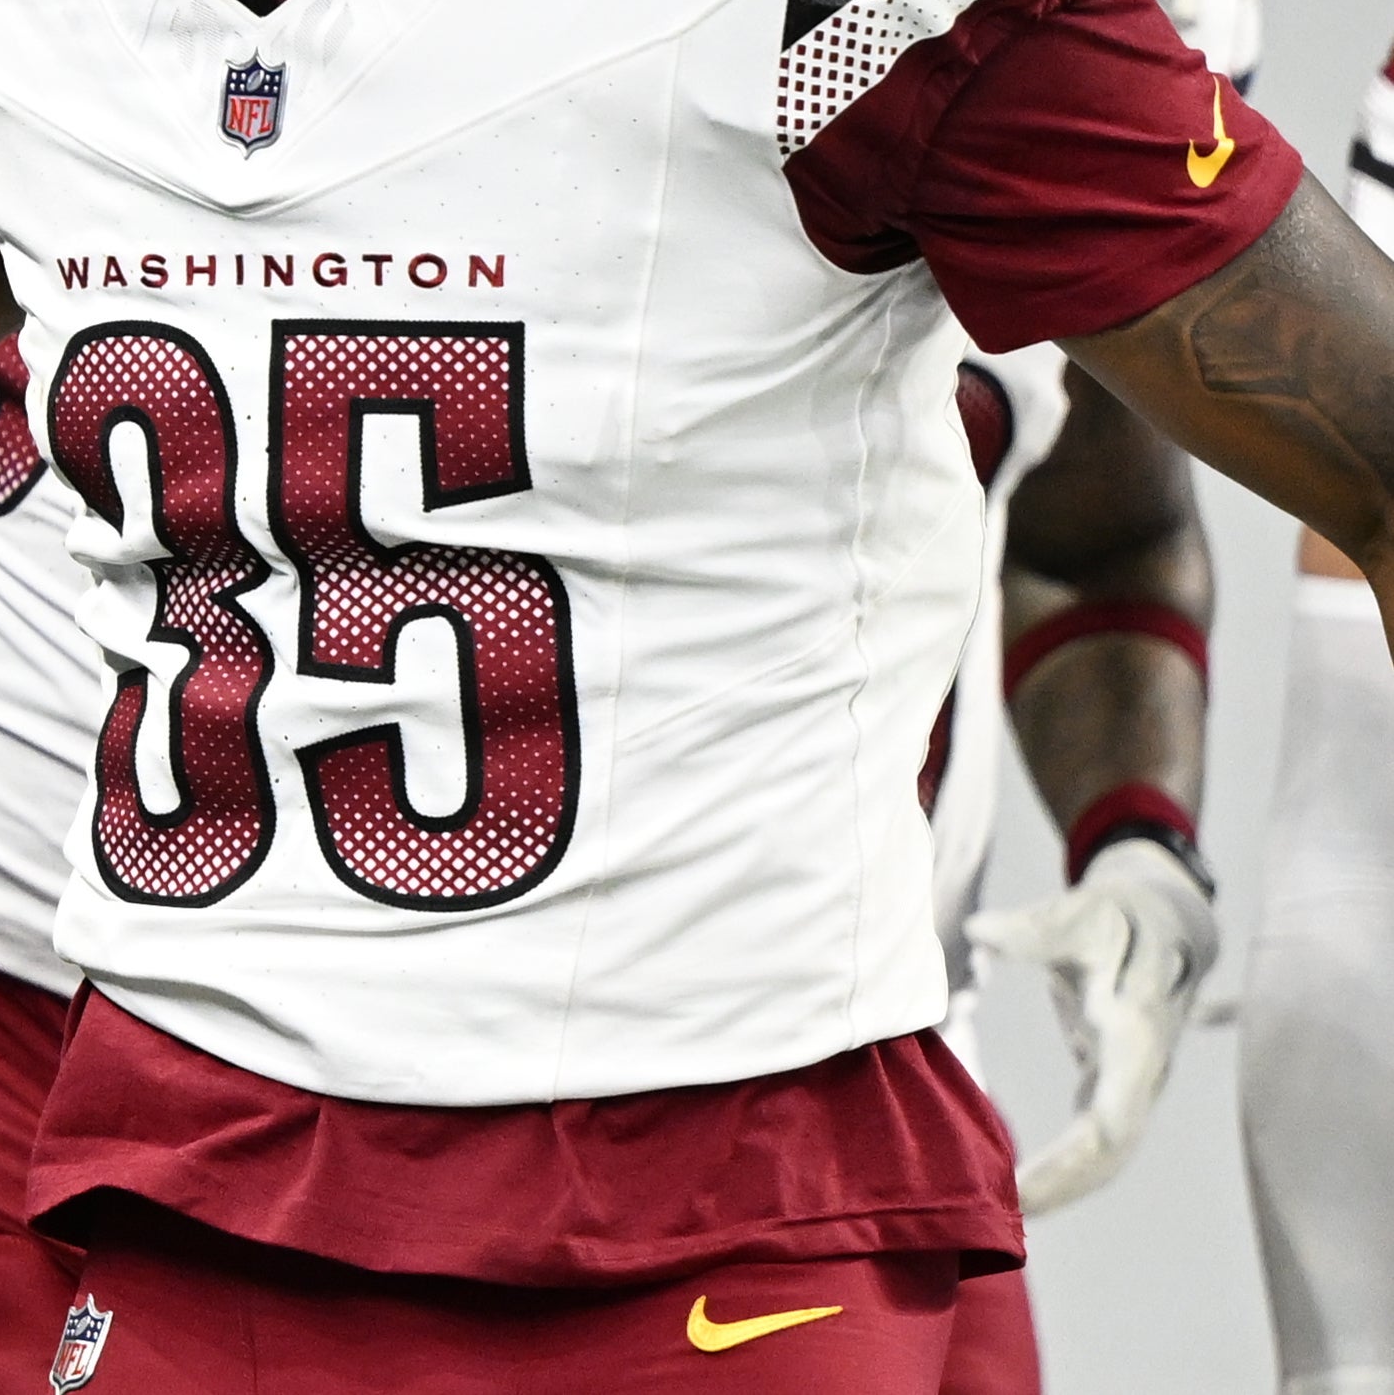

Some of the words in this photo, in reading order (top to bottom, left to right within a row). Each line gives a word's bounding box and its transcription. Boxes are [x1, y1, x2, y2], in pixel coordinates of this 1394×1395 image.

[228, 97, 273, 138] NFL
[57, 252, 505, 290] WASHINGTON
[47, 319, 582, 912] 35
[54, 1342, 88, 1380] NFL
